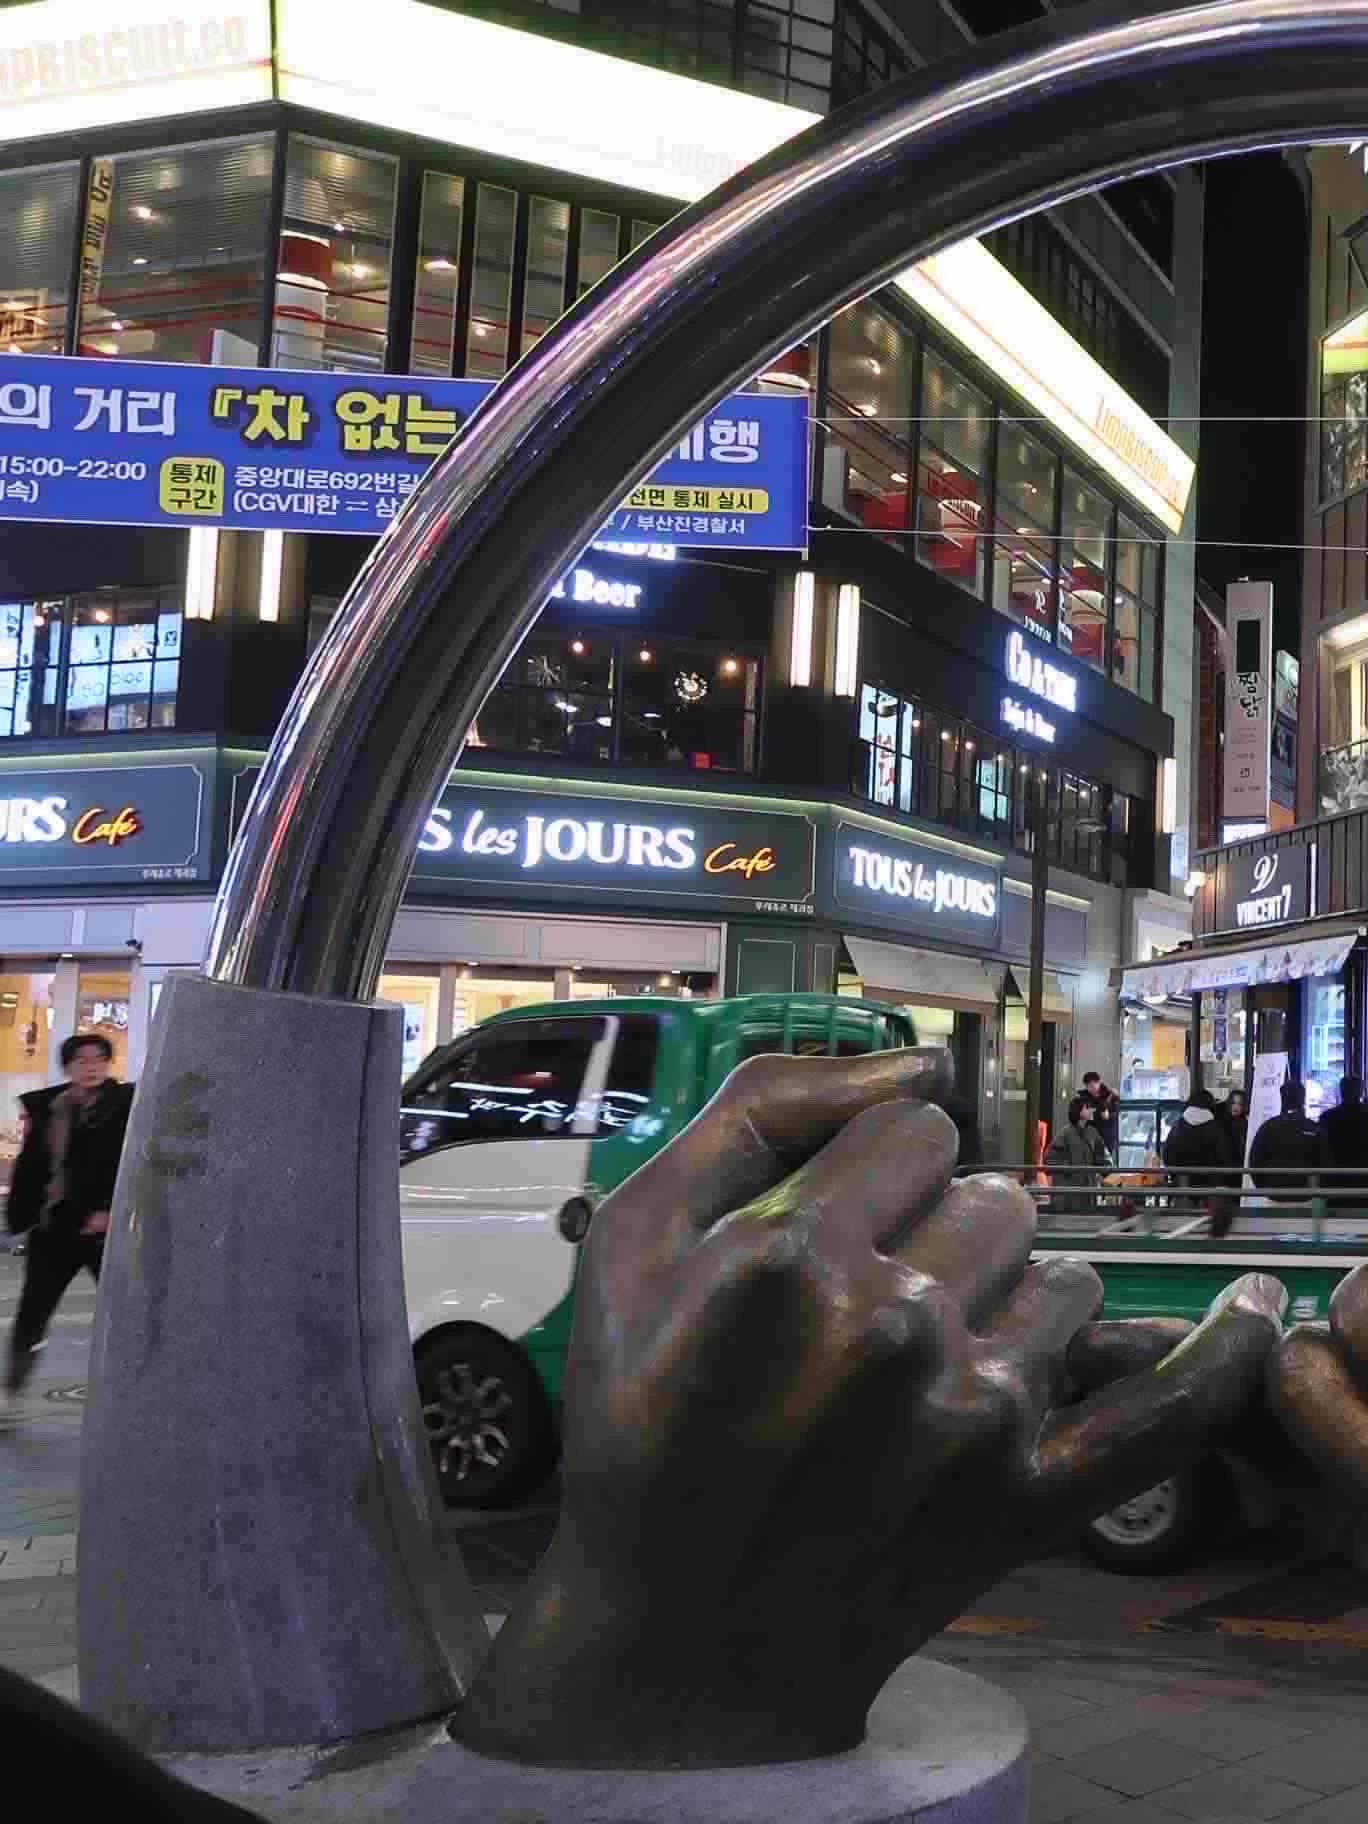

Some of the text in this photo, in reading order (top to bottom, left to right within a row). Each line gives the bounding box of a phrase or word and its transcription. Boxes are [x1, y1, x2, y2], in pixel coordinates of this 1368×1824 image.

[0, 385, 50, 430] 의
[74, 388, 176, 436] 거리
[336, 391, 458, 456] 없는
[169, 463, 217, 485] 통제
[0, 480, 40, 503] 속)
[168, 487, 217, 510] 구간
[233, 489, 408, 518] (CGV대한 삼
[672, 489, 710, 509] 통제
[718, 490, 753, 511] 실시
[637, 515, 745, 535] 부산진경찰서
[573, 569, 642, 608] Beer
[462, 808, 519, 855] les
[520, 815, 697, 870] JOURS
[848, 847, 997, 917] TOUS les JOURS
